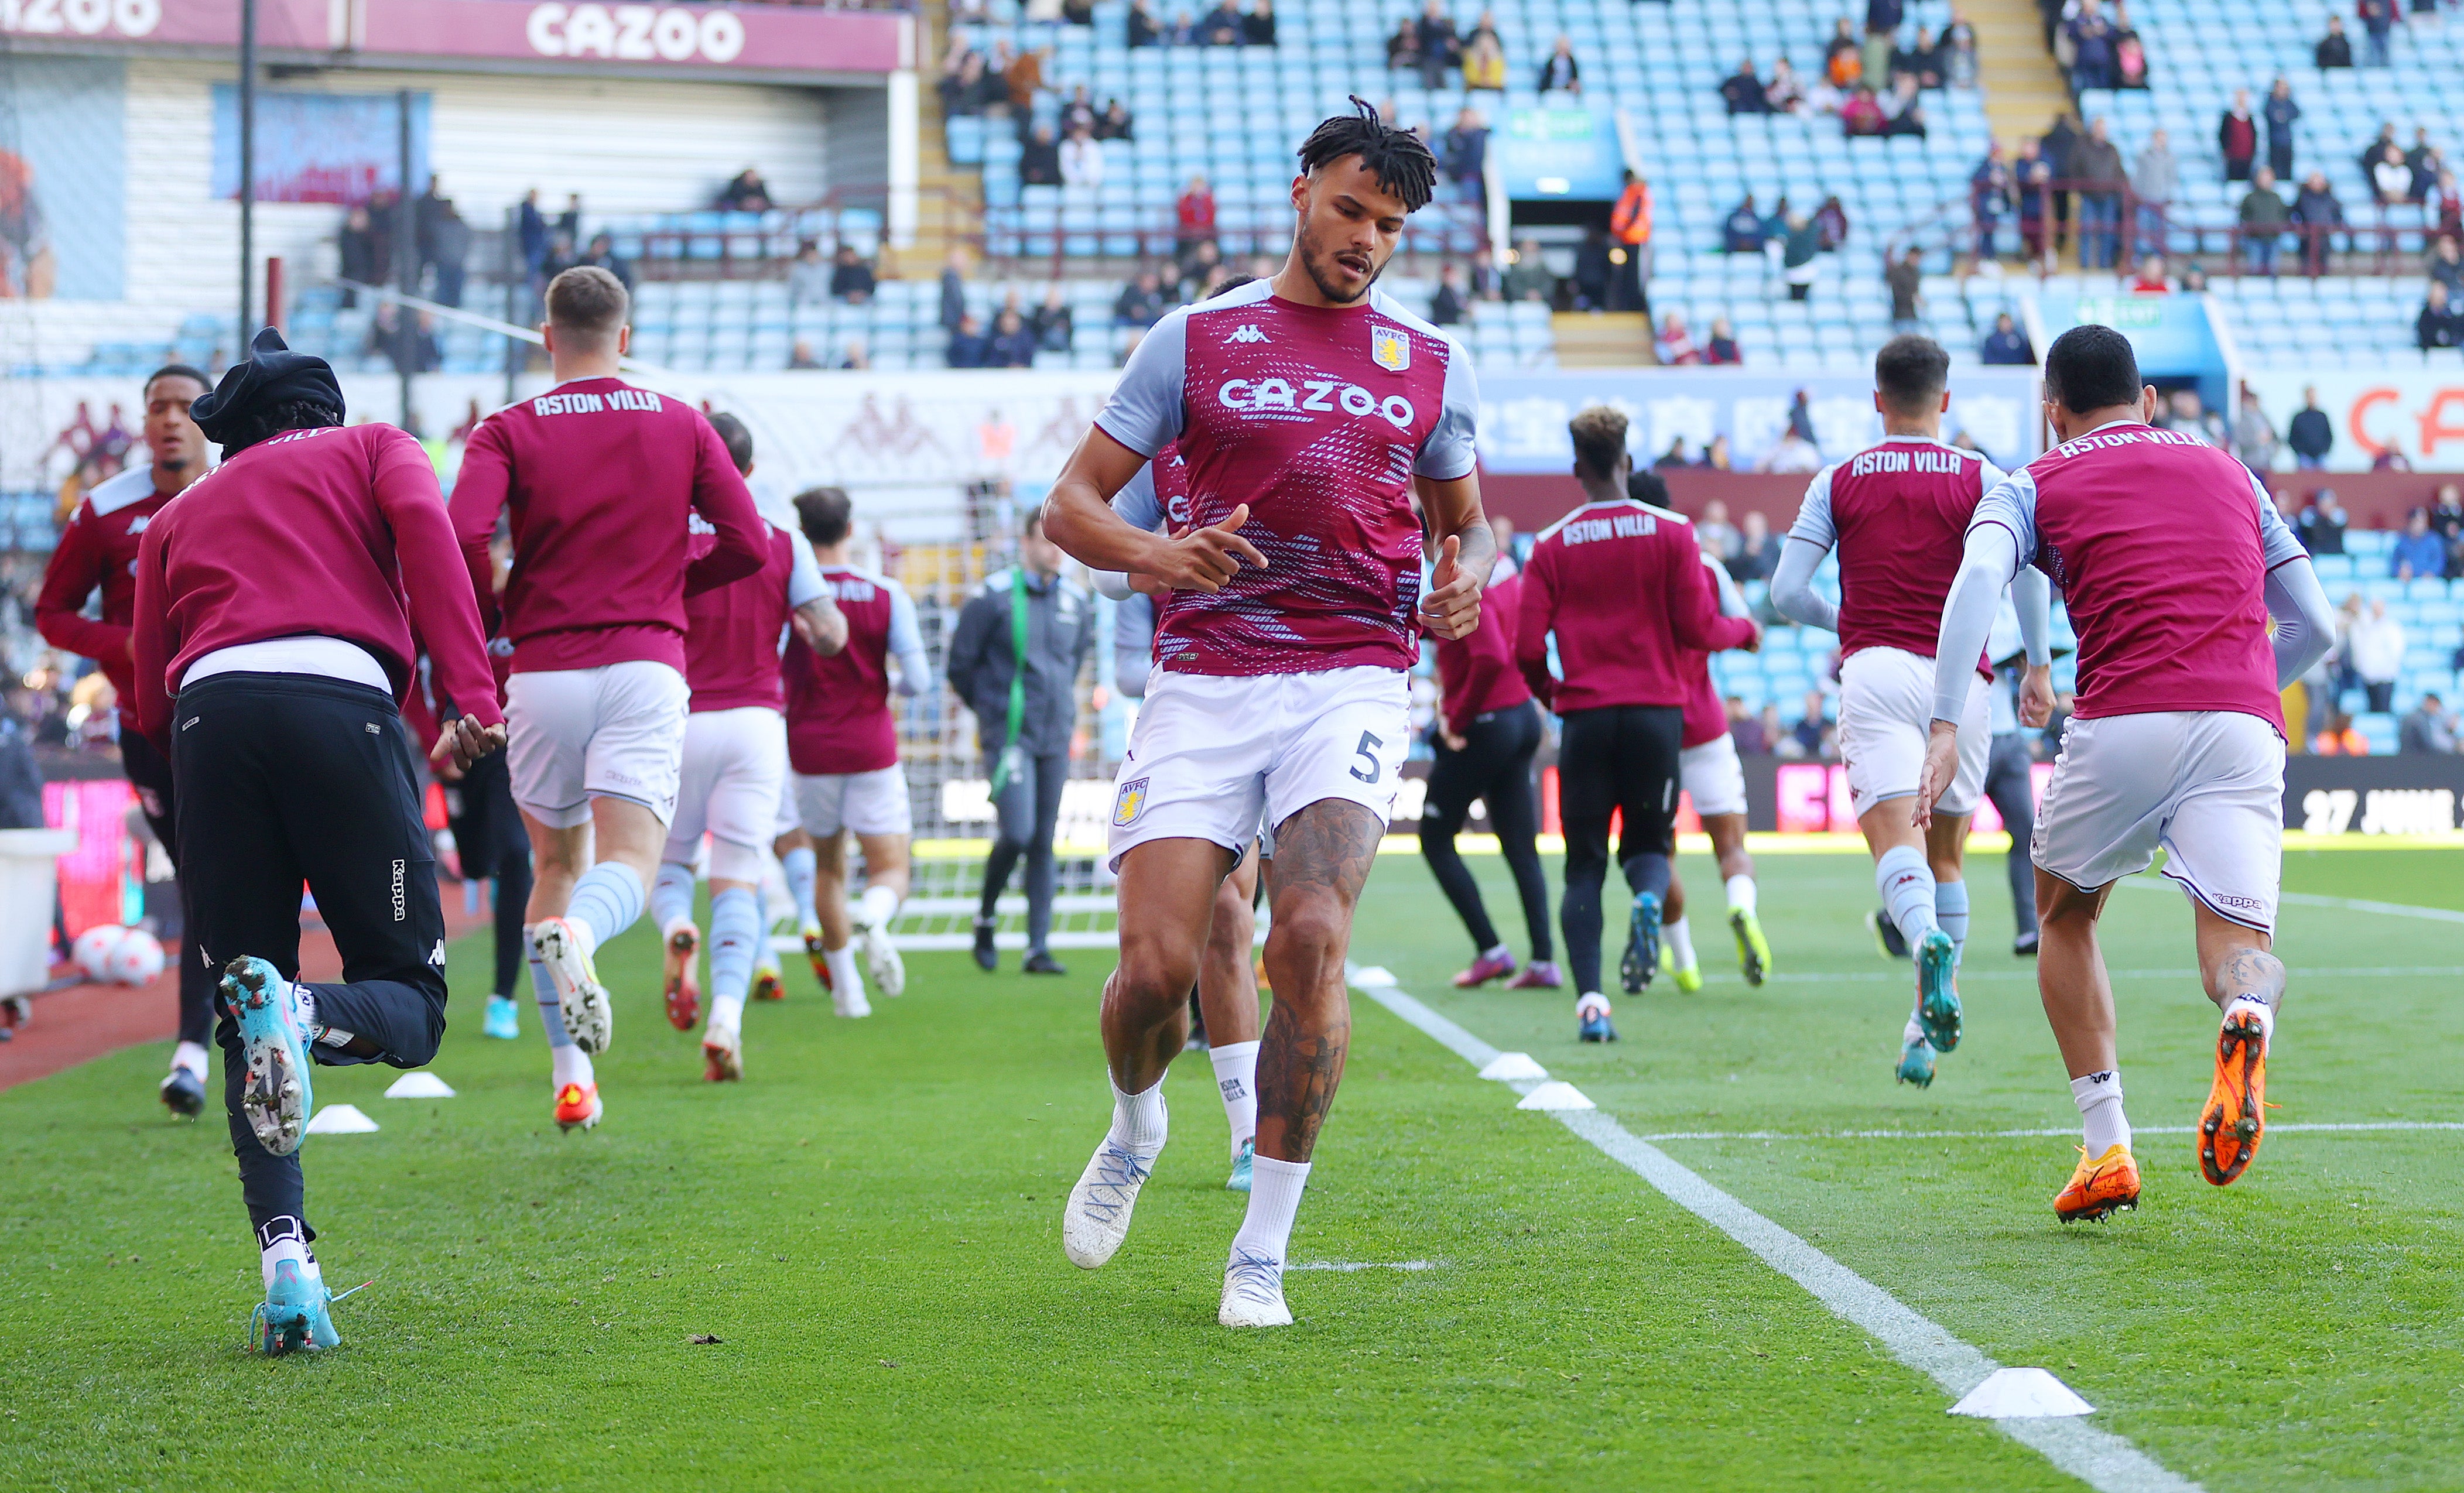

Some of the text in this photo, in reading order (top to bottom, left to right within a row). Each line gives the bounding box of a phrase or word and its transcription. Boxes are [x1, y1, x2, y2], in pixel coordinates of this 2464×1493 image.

[526, 2, 745, 63] CAZOO
[1375, 329, 1406, 342] AVFC
[533, 389, 663, 417] ASTON VILLA
[1218, 378, 1415, 427] CAZOO
[2058, 430, 2210, 458] ASTON VILLA
[1852, 450, 1962, 478] ASTON VILLA
[1562, 513, 1658, 547] ASTON VILLA
[1349, 730, 1384, 784] 5
[1121, 780, 1147, 794] AVFC
[2302, 789, 2359, 835] 27
[391, 859, 405, 922] Kappa
[2212, 893, 2261, 910] Kappa
